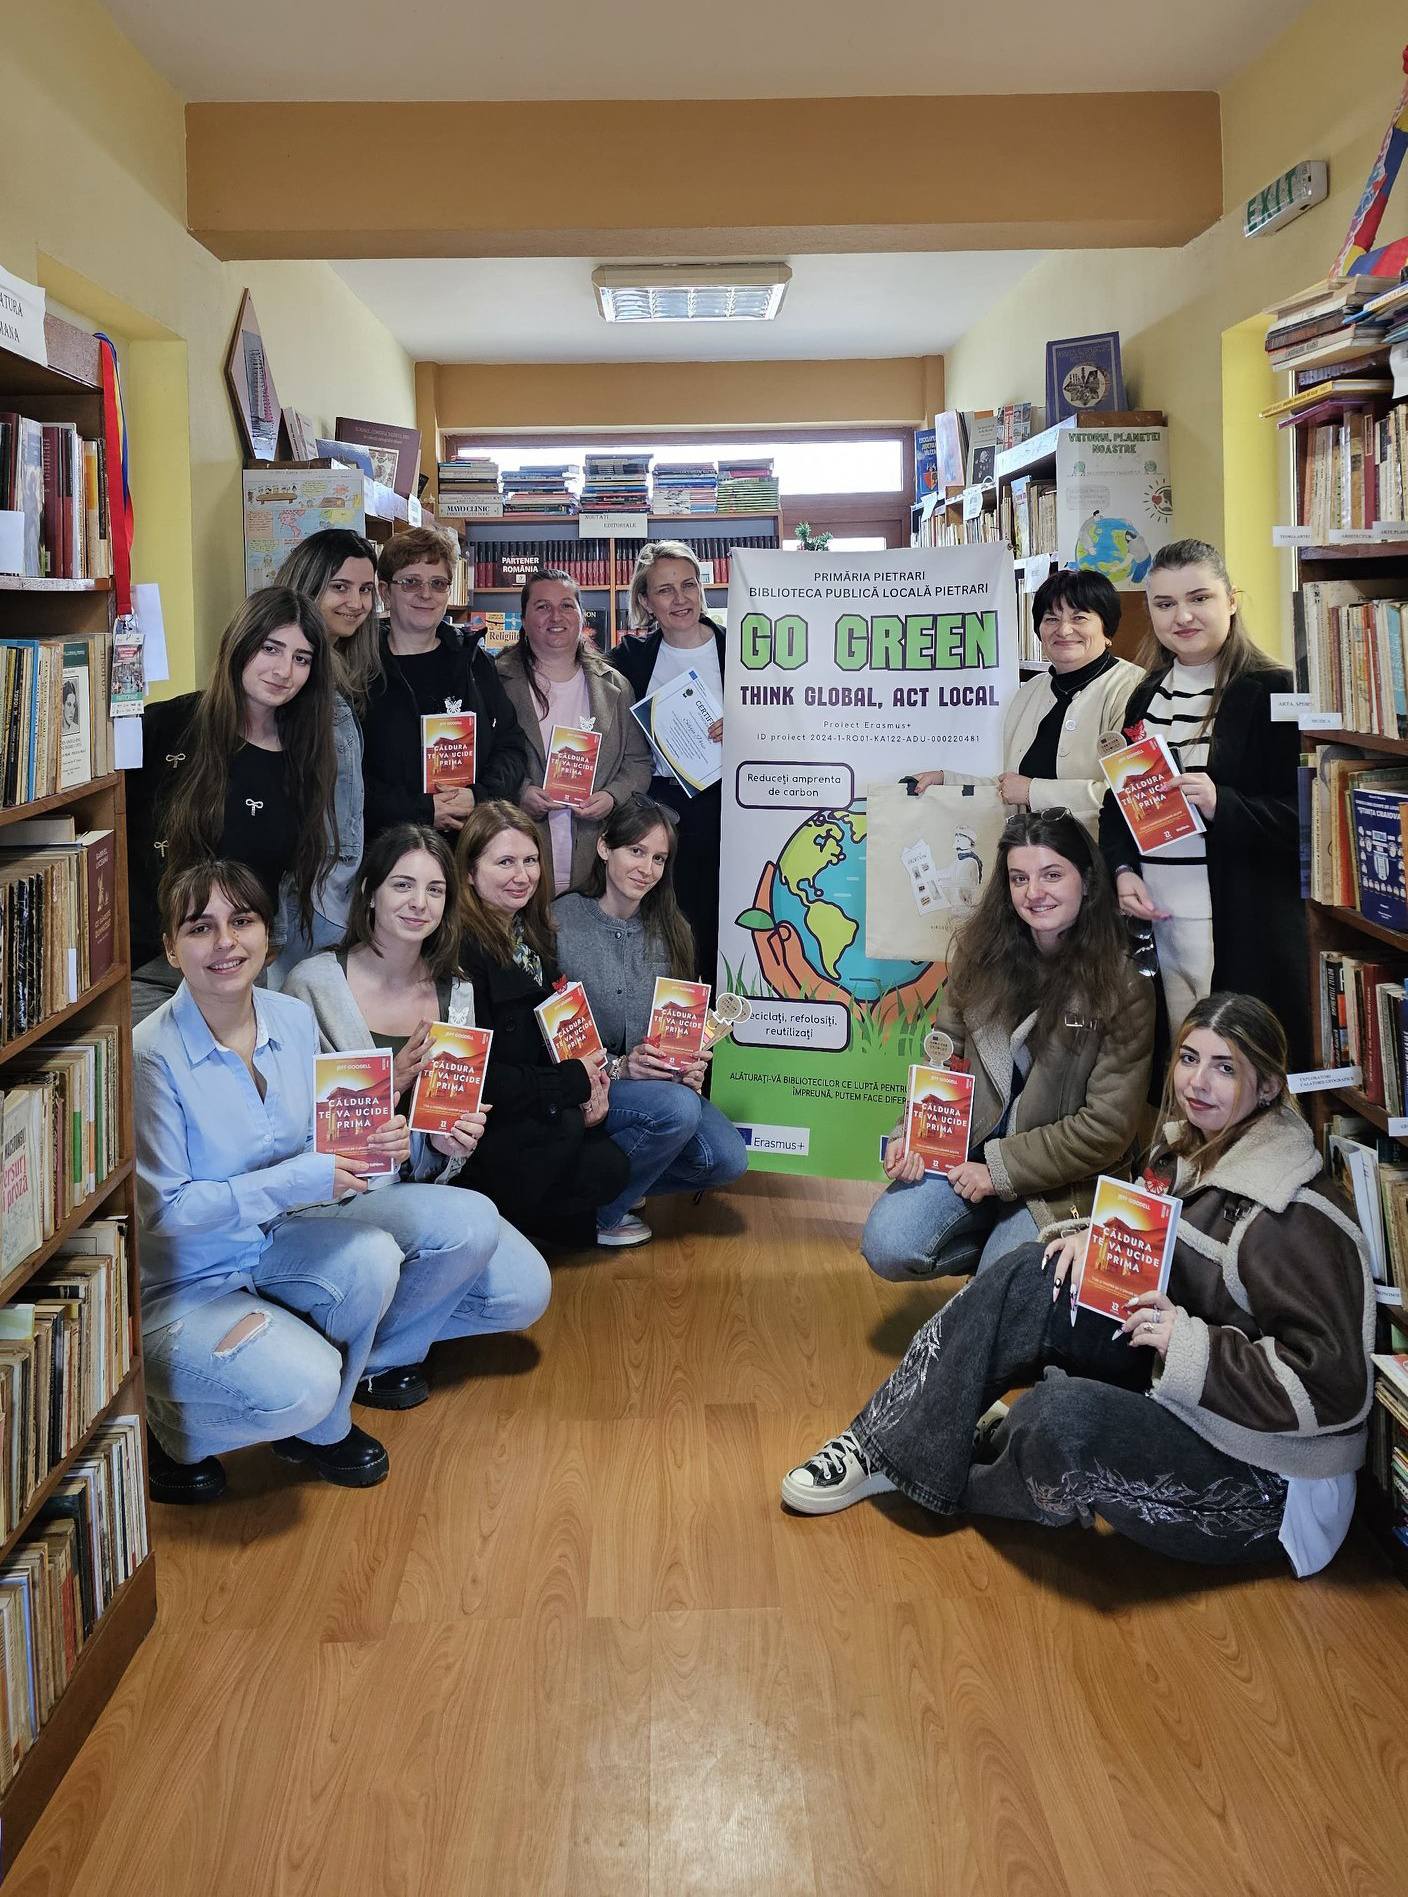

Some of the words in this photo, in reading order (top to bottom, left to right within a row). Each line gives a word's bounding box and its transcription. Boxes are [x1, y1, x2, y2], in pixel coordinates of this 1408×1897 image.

[1247, 168, 1297, 231] EXIT
[502, 557, 540, 565] PARTENER
[814, 570, 870, 582] PRIMĂRIA
[874, 570, 925, 581] PIETRARI
[749, 587, 822, 598] BIBLIOTECA
[826, 586, 879, 598] PUBLICĂ
[882, 585, 931, 597] LOCALĂ
[935, 583, 988, 596] PIETRARI
[740, 612, 808, 671] GO
[834, 610, 999, 671] GREEN
[740, 686, 794, 705] THINK
[804, 686, 883, 709] GLOBAL,
[893, 687, 929, 707] ACT
[938, 685, 999, 707] LOCAL
[824, 720, 859, 729] Proiect
[864, 720, 912, 729] Erasmus+
[757, 733, 767, 741] ID
[771, 733, 806, 743] proiect
[433, 744, 468, 752] CĂLDURA
[451, 750, 473, 758] UCIDE
[792, 774, 841, 786] amprenta
[1124, 774, 1165, 794] CĂLDURA
[768, 787, 780, 796] de
[783, 787, 819, 797] carbon
[1134, 791, 1147, 800] VA
[1138, 793, 1167, 809] PRIMA
[661, 1008, 697, 1020] CĂLDURA
[749, 1012, 787, 1024] eciclați,
[558, 1017, 586, 1038] CĂLDURA
[665, 1017, 677, 1025] VA
[679, 1019, 703, 1029] UCIDE
[564, 1033, 574, 1042] VA
[574, 1021, 593, 1036] UCIDE
[432, 1060, 475, 1074] CĂLDURA
[438, 1071, 449, 1079] VA
[453, 1074, 481, 1085] UCIDE
[783, 1076, 840, 1088] BIBLIOTECILOR
[841, 1080, 852, 1089] CE
[854, 1080, 879, 1091] LUPTĂ
[436, 1082, 465, 1092] PRIMA
[328, 1097, 379, 1107] CĂLDURA
[835, 1092, 862, 1101] PUTEM
[863, 1094, 883, 1102] FACE
[336, 1109, 351, 1118] VA
[356, 1107, 388, 1117] UCIDE
[921, 1102, 961, 1117] CĂLDURA
[337, 1119, 371, 1129] PRIMA
[927, 1113, 938, 1122] VA
[941, 1115, 968, 1127] UCIDE
[926, 1122, 953, 1134] PRIMA
[754, 1137, 805, 1151] Erasmus+
[1103, 1226, 1152, 1252] CĂLDURA
[1108, 1242, 1122, 1254] VA
[1126, 1249, 1160, 1268] UCIDE
[1107, 1252, 1140, 1273] PRIMA
